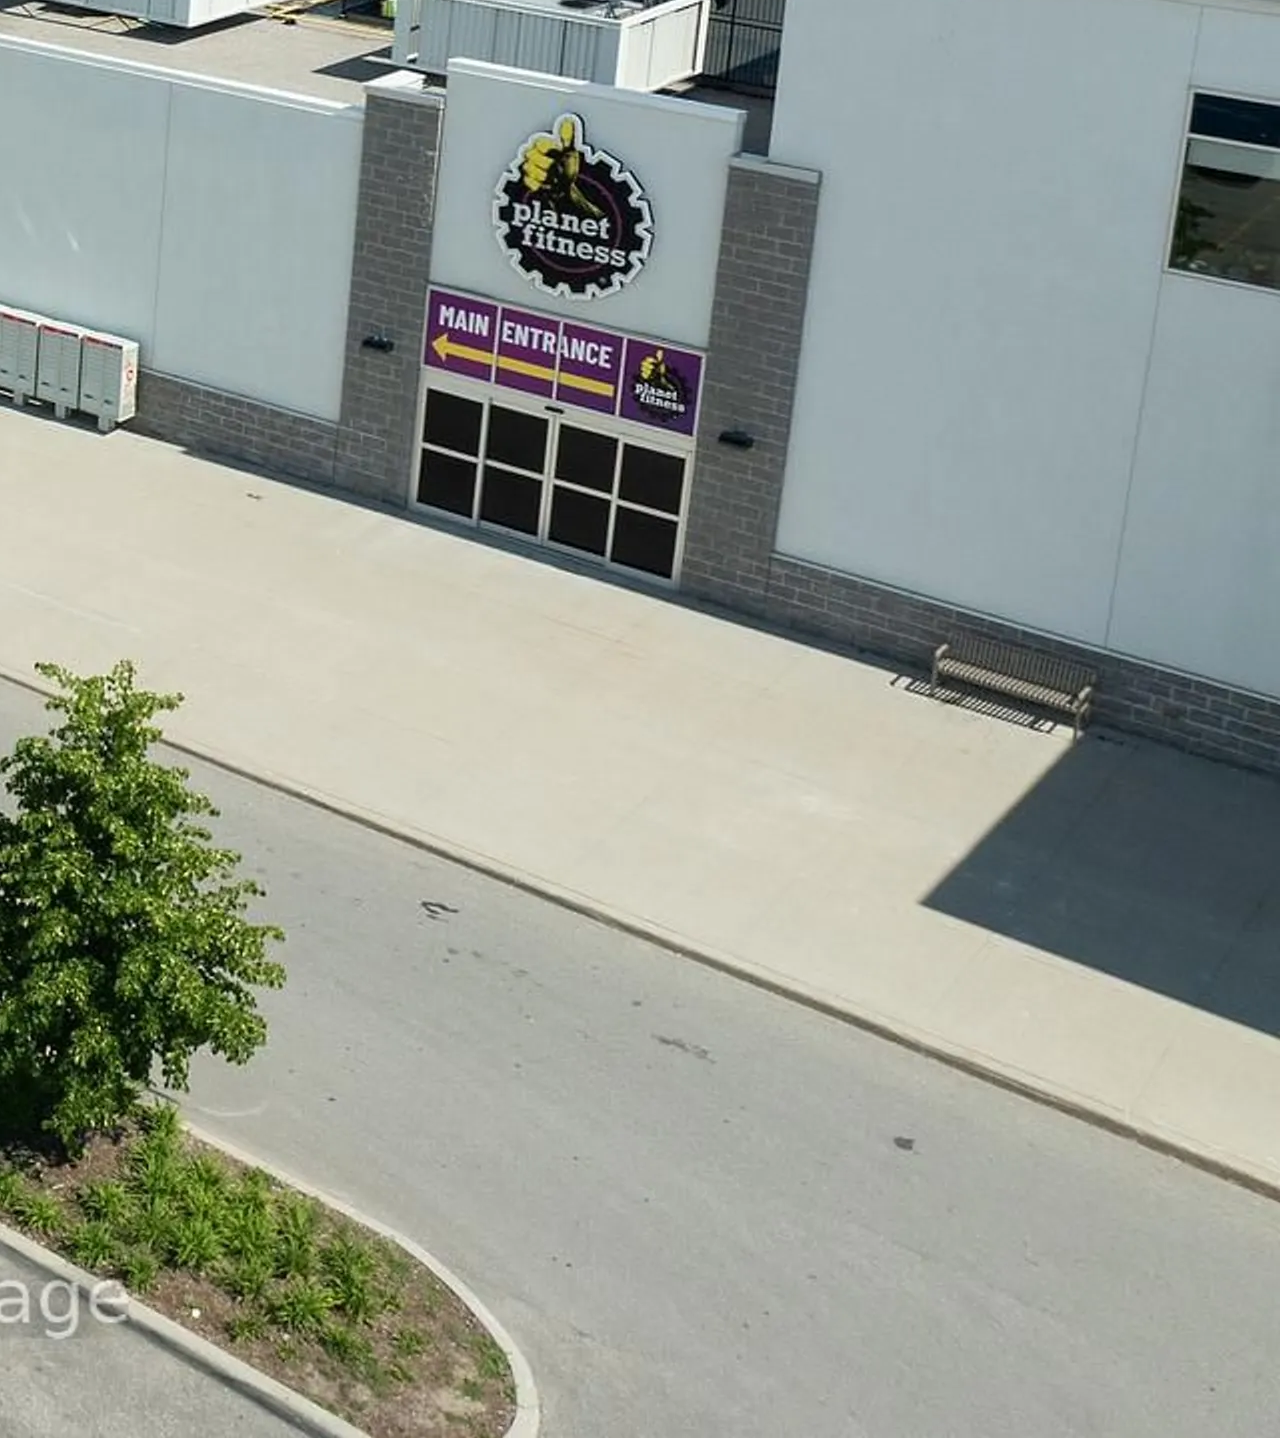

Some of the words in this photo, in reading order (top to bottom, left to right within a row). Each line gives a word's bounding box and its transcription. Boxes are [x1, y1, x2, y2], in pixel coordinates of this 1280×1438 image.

[511, 199, 610, 239] planet
[521, 223, 626, 267] fitness
[438, 304, 490, 337] MAIN
[502, 320, 613, 369] ENTRANCE
[634, 382, 678, 401] planet
[639, 392, 686, 413] fitness
